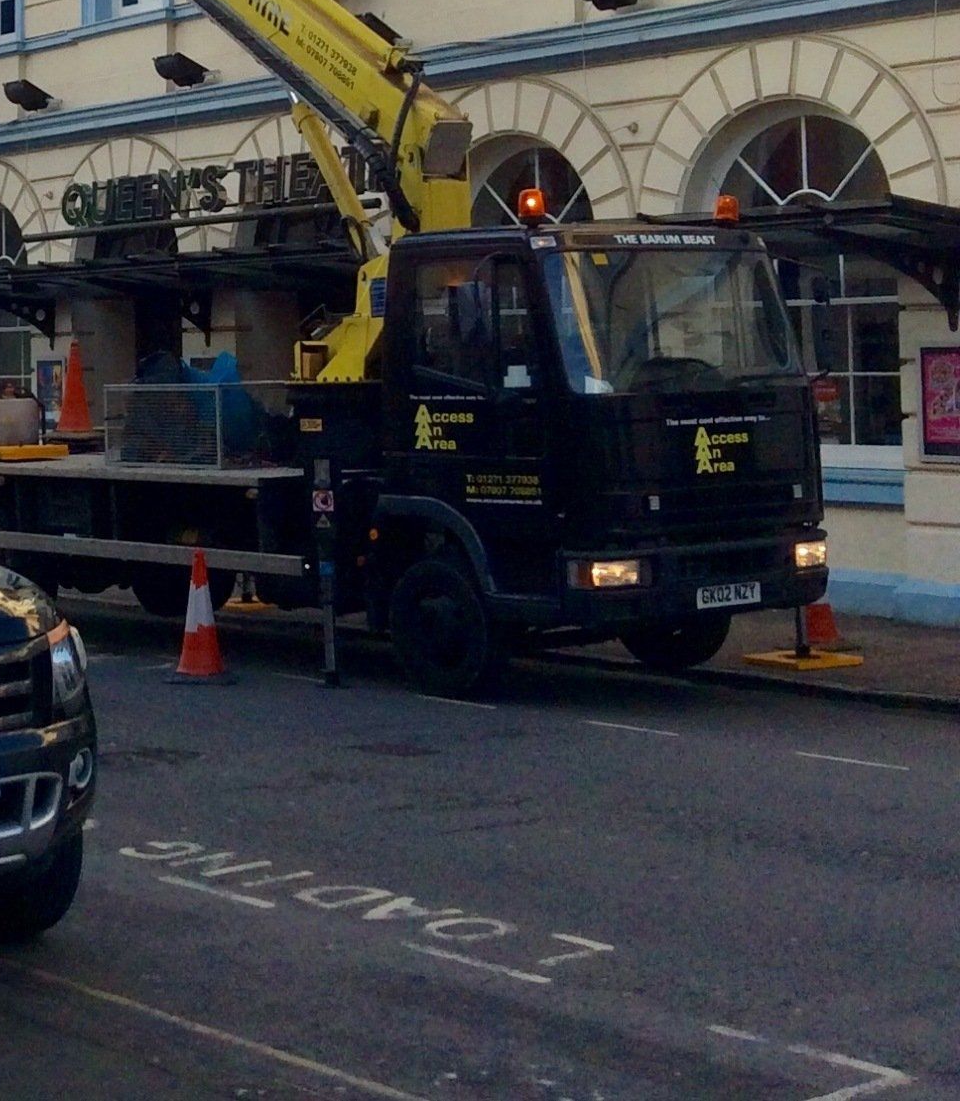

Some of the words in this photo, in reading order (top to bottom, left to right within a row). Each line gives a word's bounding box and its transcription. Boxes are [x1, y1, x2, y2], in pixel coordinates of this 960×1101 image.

[62, 164, 228, 227] QUEEN'S
[614, 235, 638, 244] THE
[639, 234, 681, 244] BARUM
[681, 235, 716, 244] BEAST
[414, 403, 474, 423] Access
[414, 419, 442, 436] An
[694, 426, 749, 446] Access
[415, 434, 457, 450] Area
[695, 443, 722, 460] An
[696, 457, 735, 475] Area
